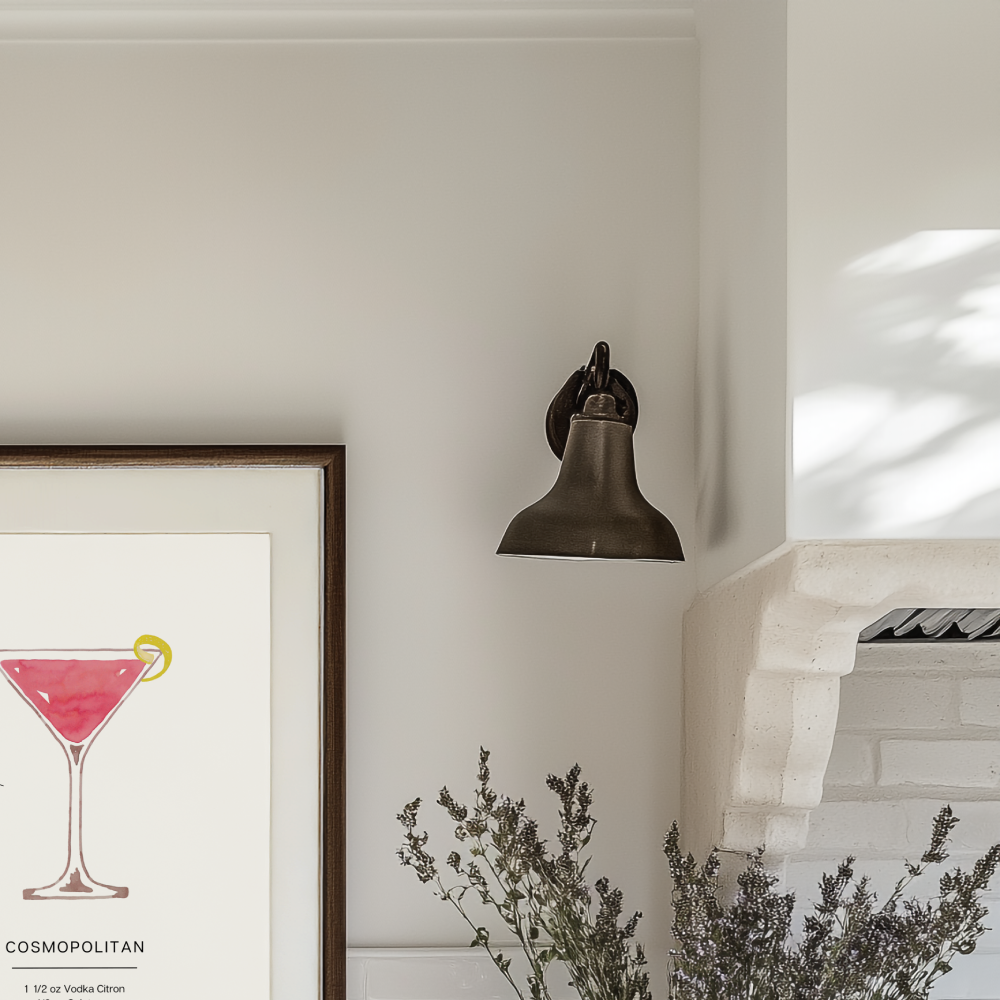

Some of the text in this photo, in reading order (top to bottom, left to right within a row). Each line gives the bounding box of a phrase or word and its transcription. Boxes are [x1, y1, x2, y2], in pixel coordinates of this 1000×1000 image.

[5, 940, 144, 954] COSMOPOLITAN
[24, 984, 126, 994] 1 1/2 oz Vodka Citron
